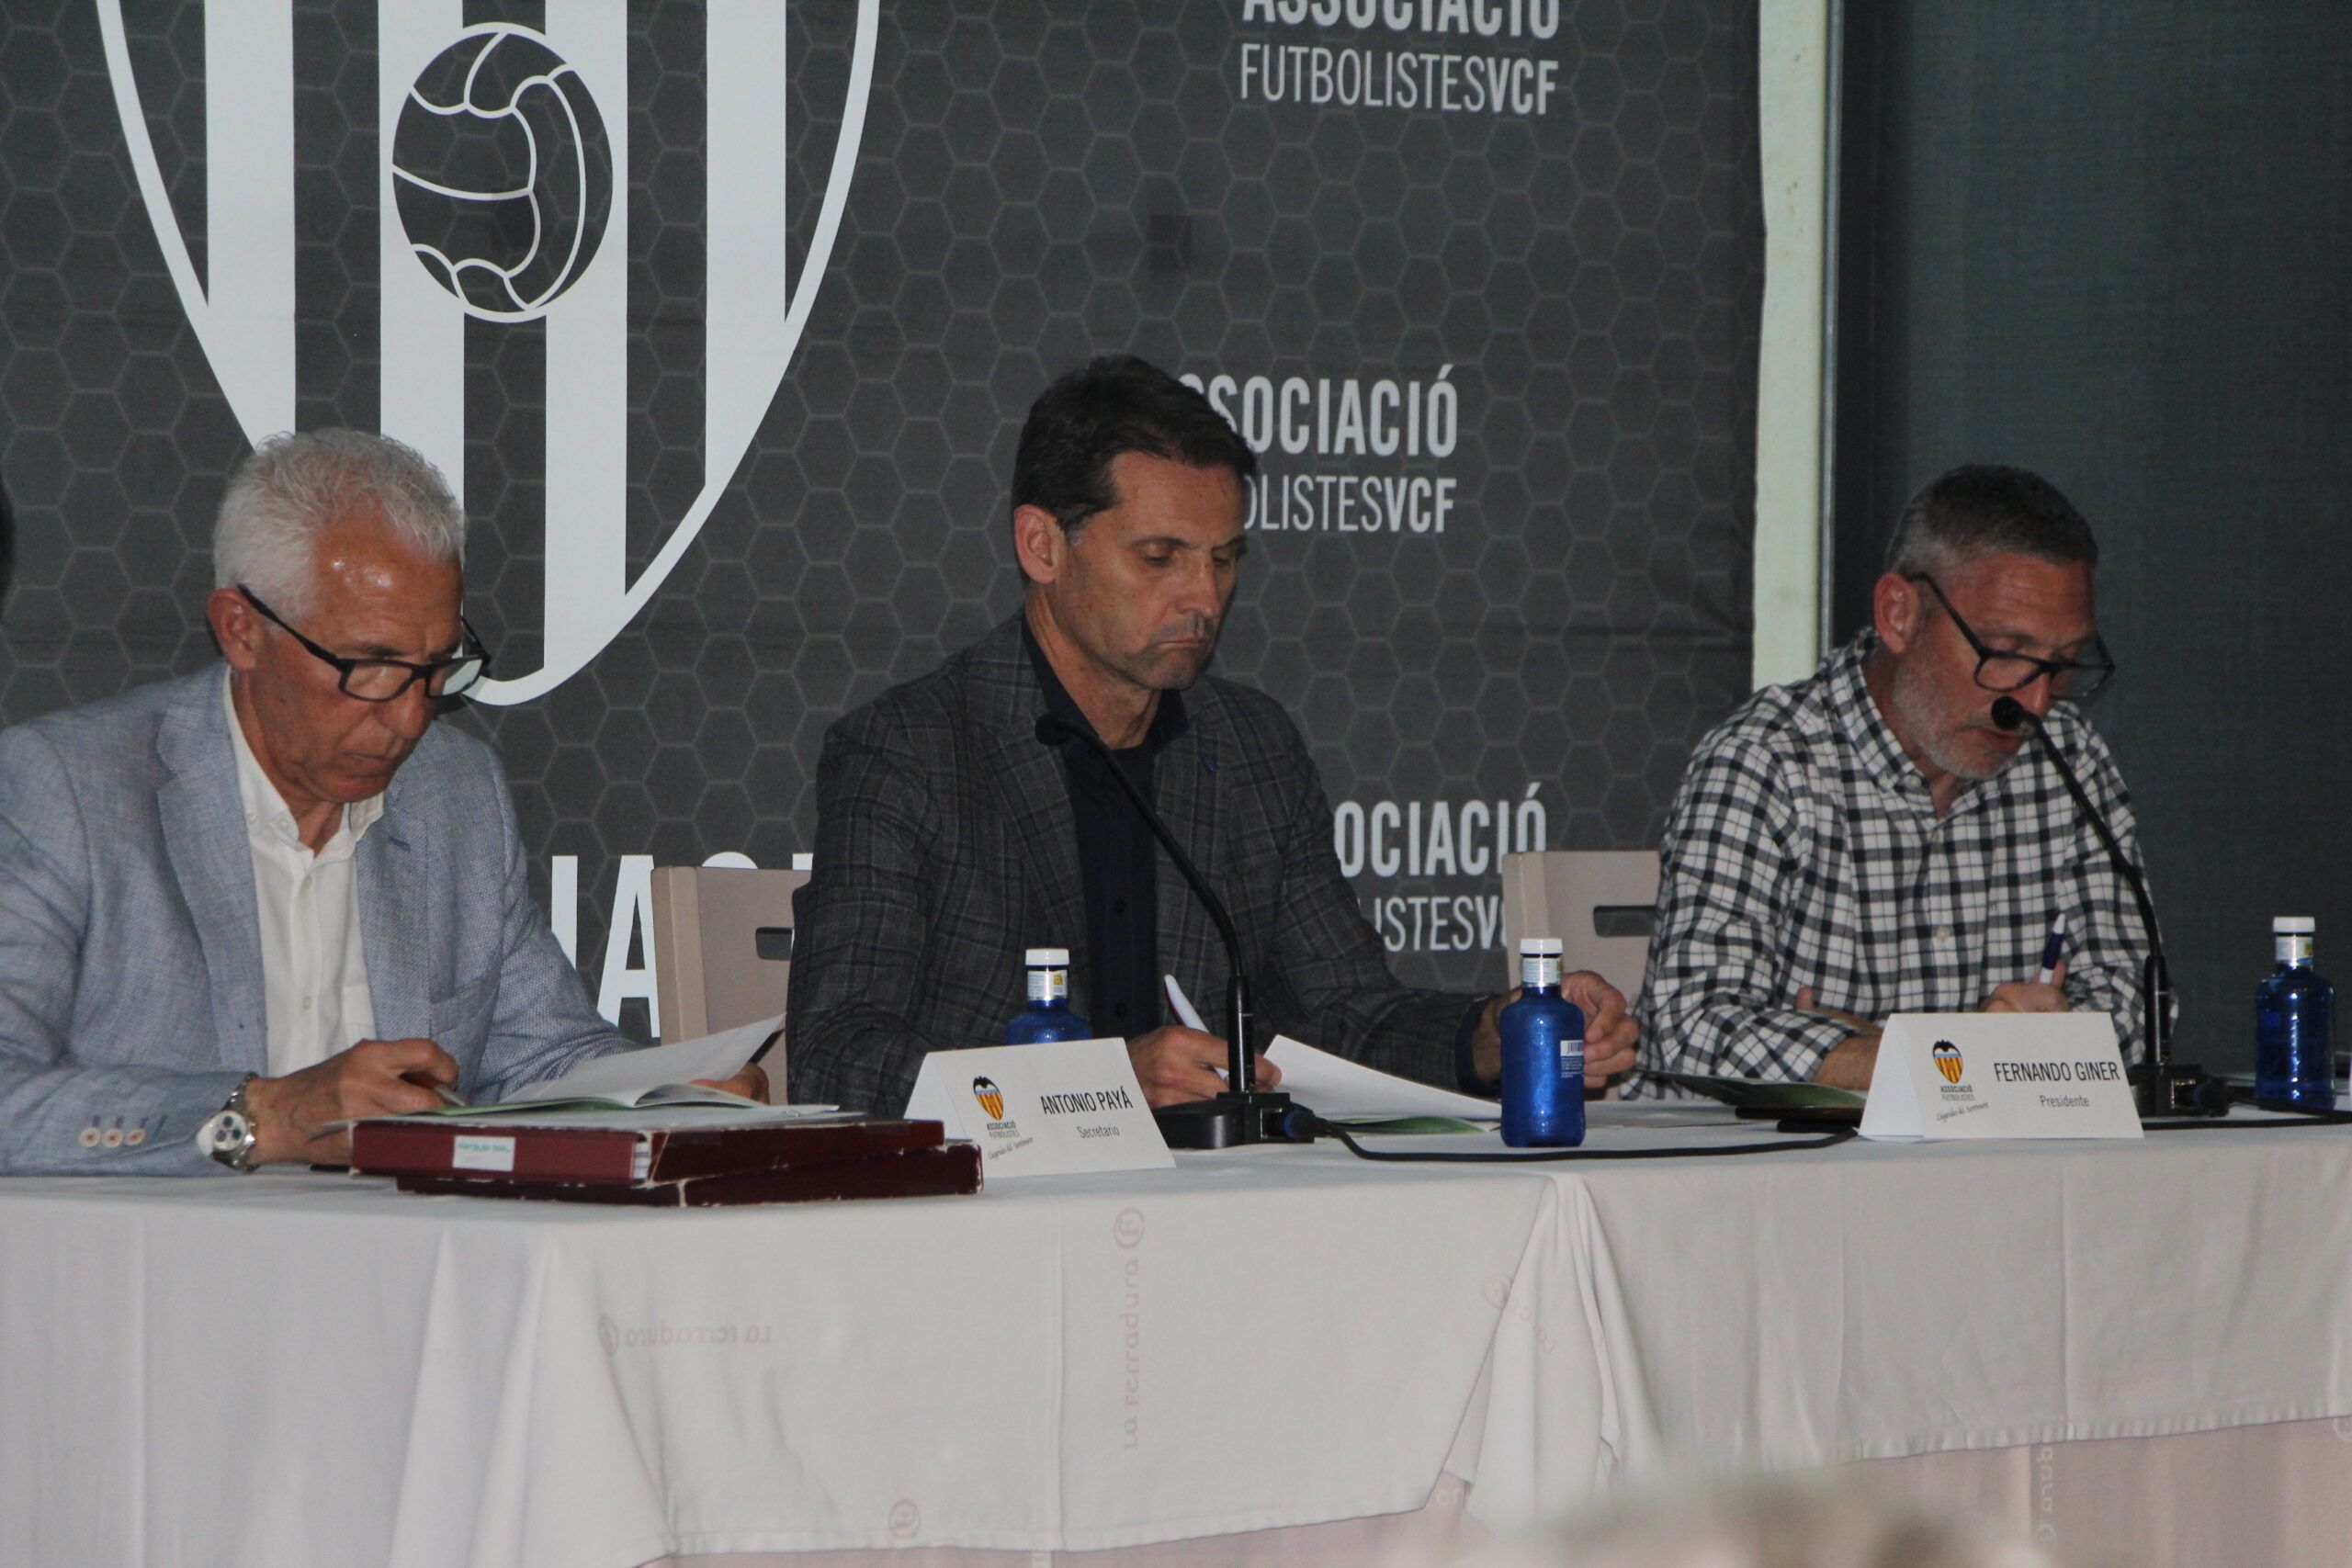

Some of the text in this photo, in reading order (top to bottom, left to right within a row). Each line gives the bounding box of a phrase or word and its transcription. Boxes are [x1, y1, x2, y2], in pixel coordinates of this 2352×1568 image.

[1240, 42, 1559, 116] FUTBOLISTESVCF
[1993, 1061, 2121, 1082] FERNANDO GINER
[1040, 1085, 1135, 1115] ANTONIO PAYÁ
[2039, 1095, 2090, 1108] Presidente
[1076, 1124, 1121, 1139] Secretario
